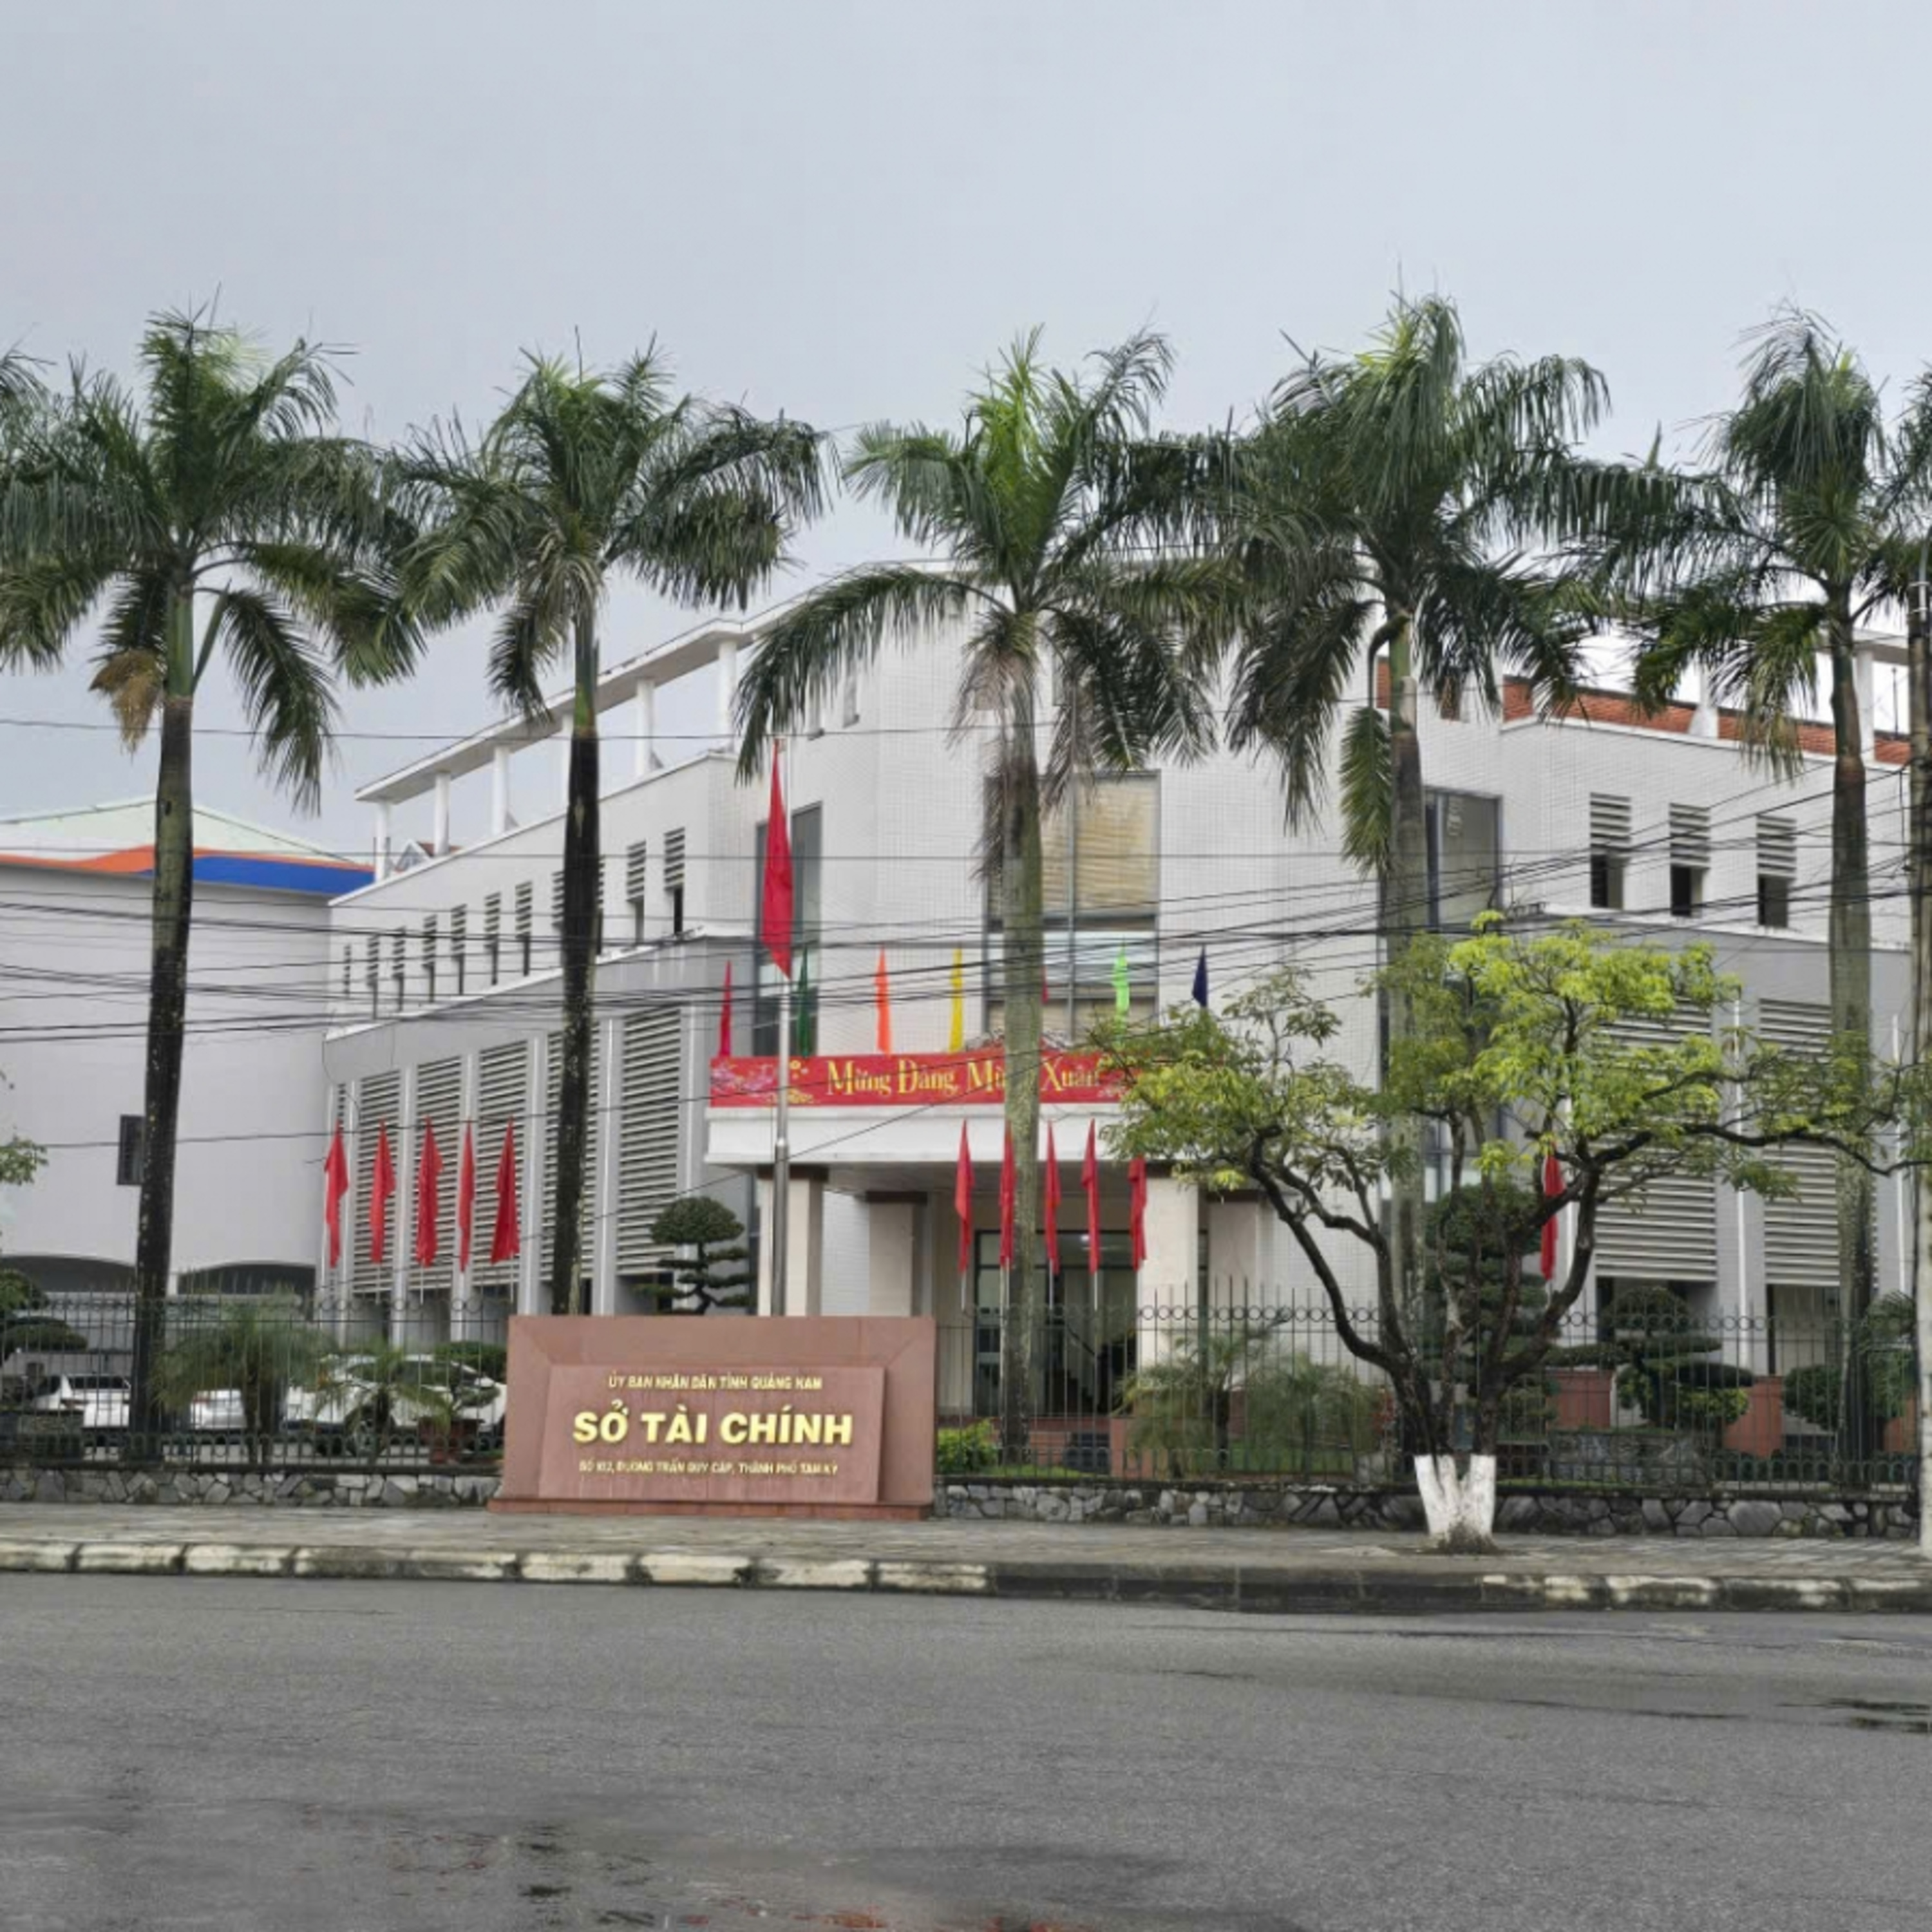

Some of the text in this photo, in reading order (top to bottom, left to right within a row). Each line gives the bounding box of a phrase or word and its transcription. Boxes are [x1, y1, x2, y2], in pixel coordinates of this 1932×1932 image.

[967, 1059, 1005, 1092] Mừ
[629, 1375, 653, 1388] BAN
[656, 1373, 689, 1389] NHÂN
[691, 1374, 716, 1389] DÂN
[796, 1376, 822, 1389] NAM
[573, 1399, 853, 1444] SỞ TÀI CHÍNH
